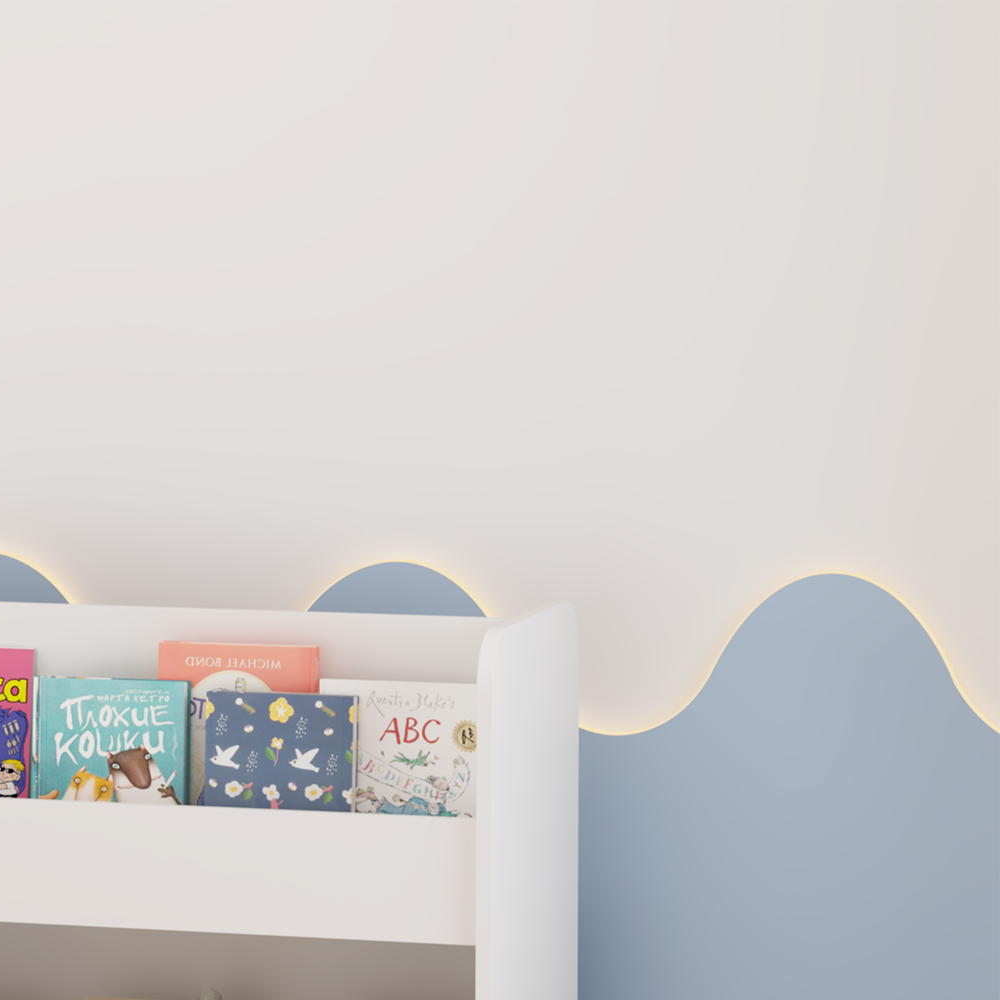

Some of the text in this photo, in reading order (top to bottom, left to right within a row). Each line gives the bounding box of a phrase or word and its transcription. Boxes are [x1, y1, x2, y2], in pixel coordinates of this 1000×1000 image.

[60, 694, 175, 731] ПЛОХИЕ
[97, 694, 170, 703] МАРТА КЕТРО
[365, 690, 456, 718] Quentin Blake's
[379, 717, 442, 745] ABC
[54, 728, 166, 767] КОШКИ
